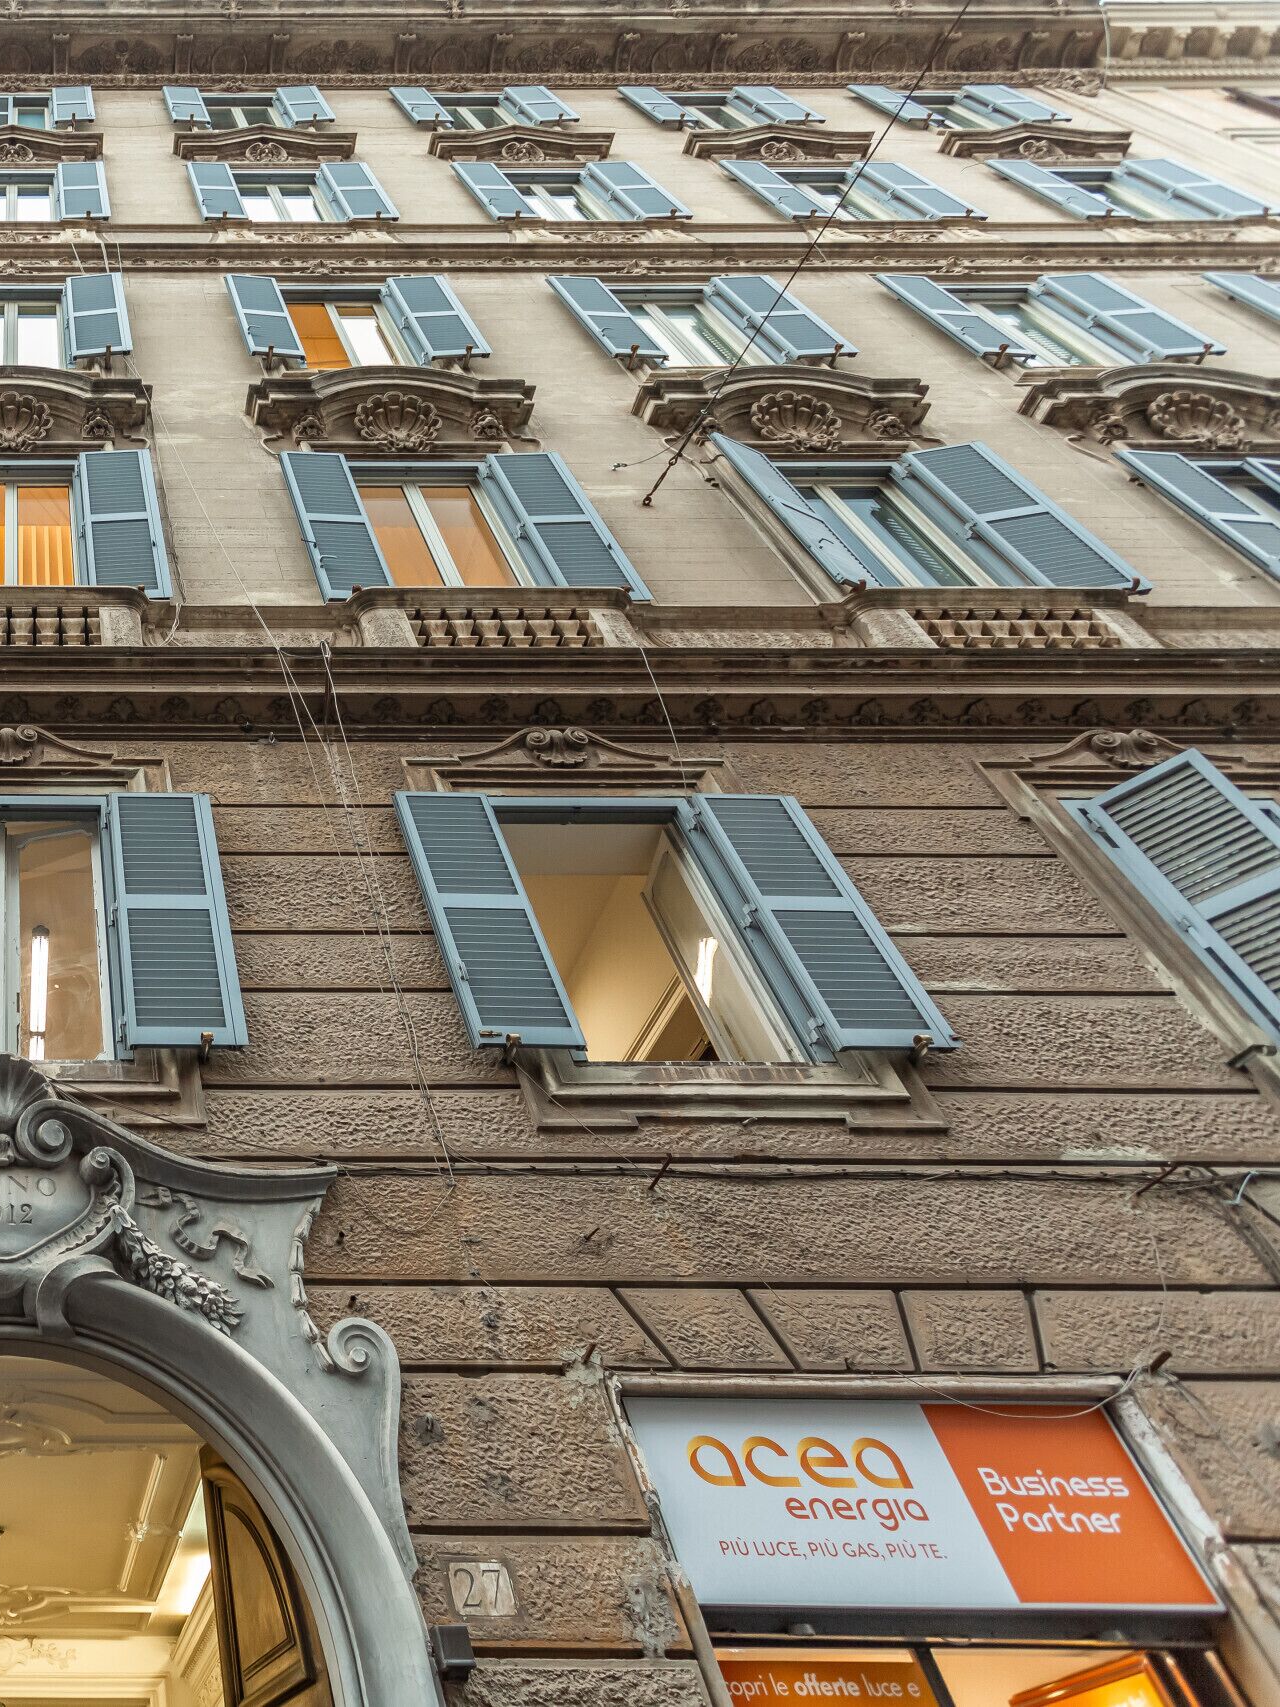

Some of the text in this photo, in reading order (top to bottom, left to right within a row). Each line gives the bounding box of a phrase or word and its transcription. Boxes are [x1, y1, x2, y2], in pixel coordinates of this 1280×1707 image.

[686, 1435, 914, 1489] acea
[977, 1467, 1130, 1497] Business
[785, 1497, 930, 1531] energia
[995, 1502, 1121, 1533] Partner
[719, 1537, 948, 1562] PIÙ LUCE, PIÙ GAS, PIÙ TE.
[453, 1567, 500, 1609] 27
[769, 1672, 789, 1696] le
[793, 1672, 860, 1697] offerte
[861, 1673, 903, 1697] luce
[907, 1680, 920, 1697] e
